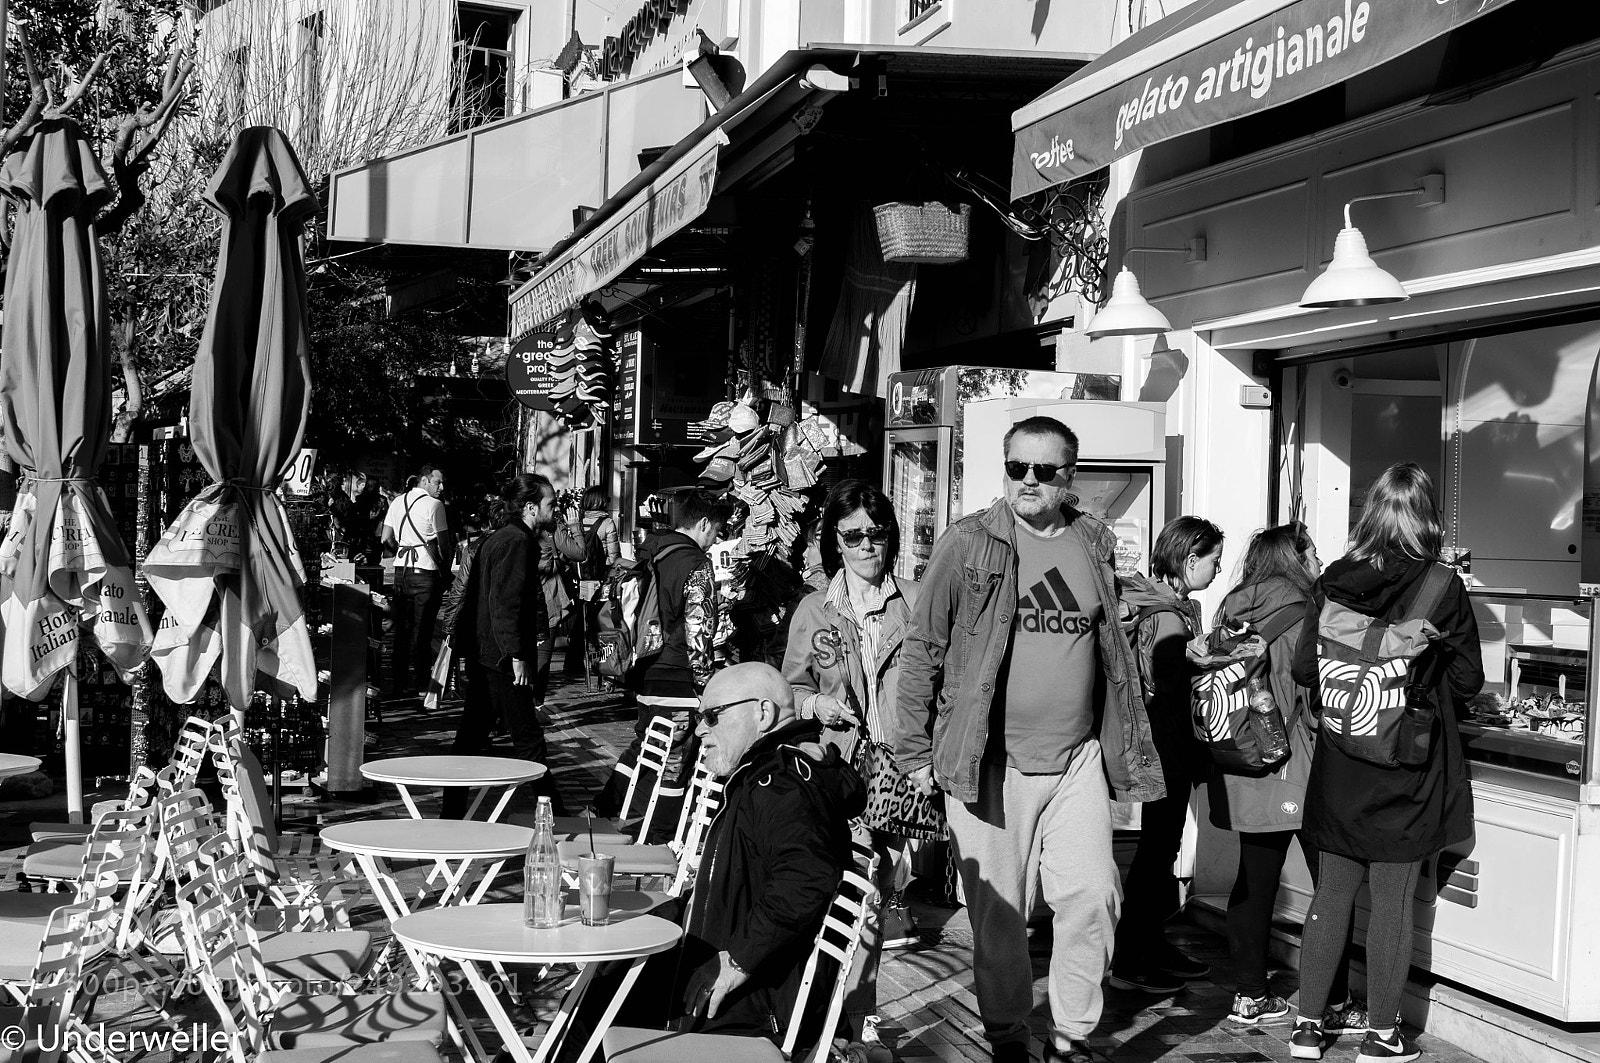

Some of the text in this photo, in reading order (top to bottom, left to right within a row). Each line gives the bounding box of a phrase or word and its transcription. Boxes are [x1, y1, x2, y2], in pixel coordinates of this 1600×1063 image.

[1114, 0, 1370, 150] gelato artigianale
[590, 228, 620, 282] GREEK
[537, 340, 554, 349] the
[526, 363, 547, 375] proj
[206, 523, 240, 538] CRE
[207, 537, 229, 546] SHOP
[100, 579, 125, 599] lato
[30, 628, 77, 662] Italian
